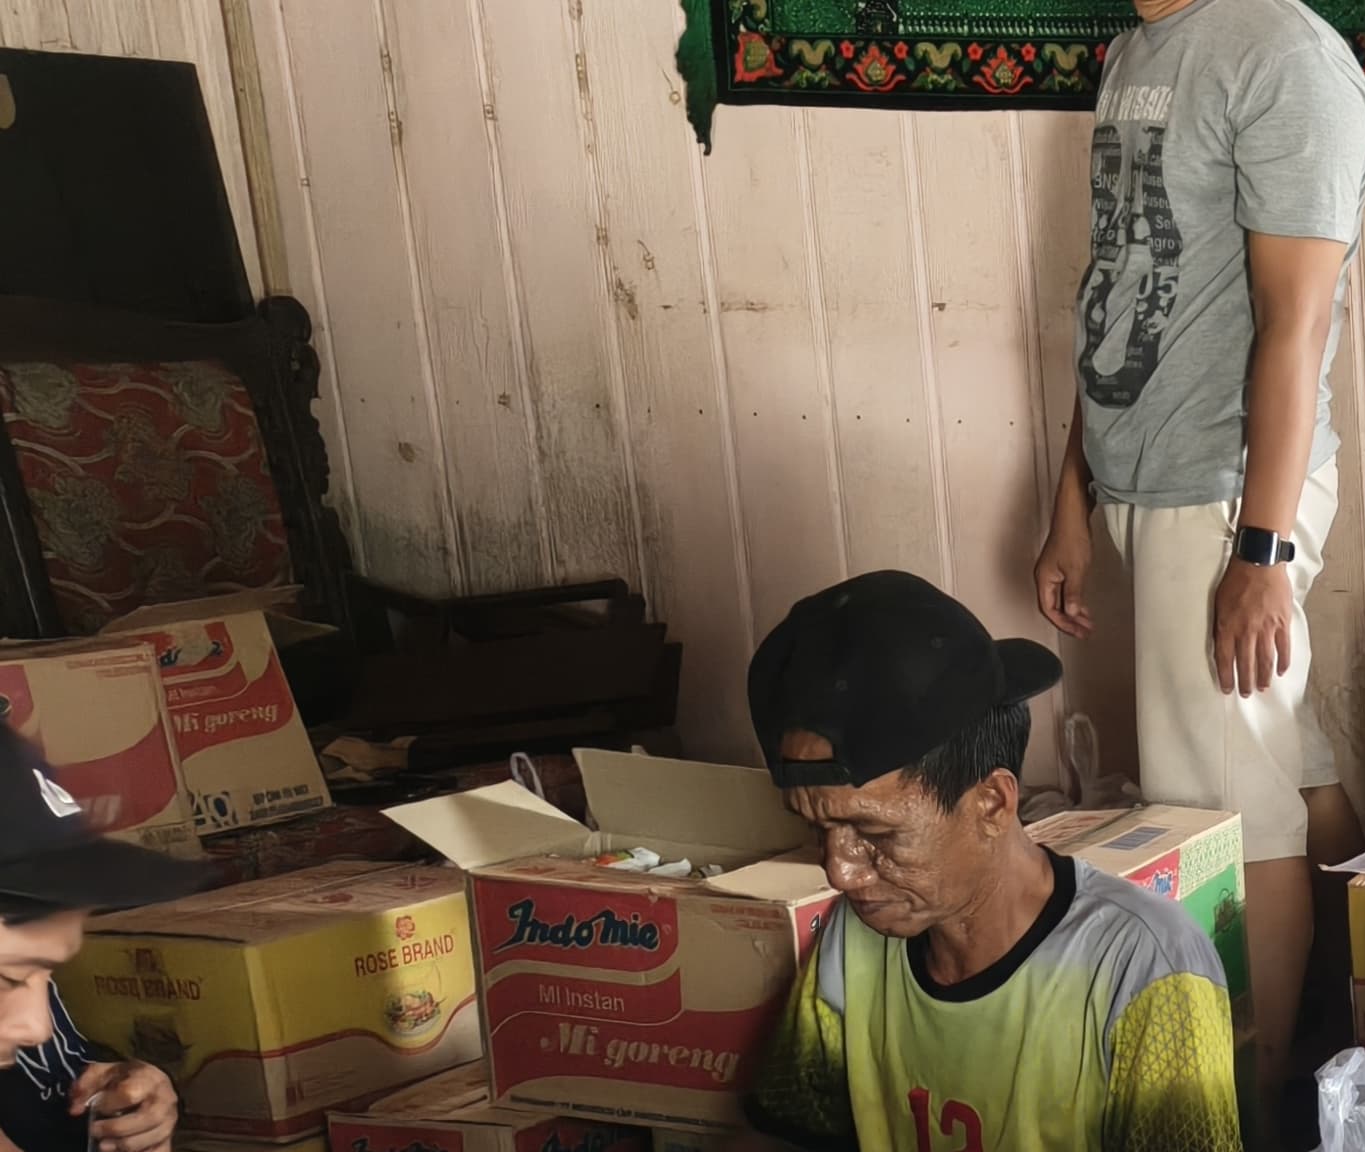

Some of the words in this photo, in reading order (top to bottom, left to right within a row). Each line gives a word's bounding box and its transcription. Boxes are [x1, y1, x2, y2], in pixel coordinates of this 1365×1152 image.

[202, 702, 279, 734] goreng
[354, 949, 399, 976] ROSE
[400, 934, 454, 966] BRAND
[566, 985, 625, 1013] Instan
[604, 1036, 740, 1083] goreng
